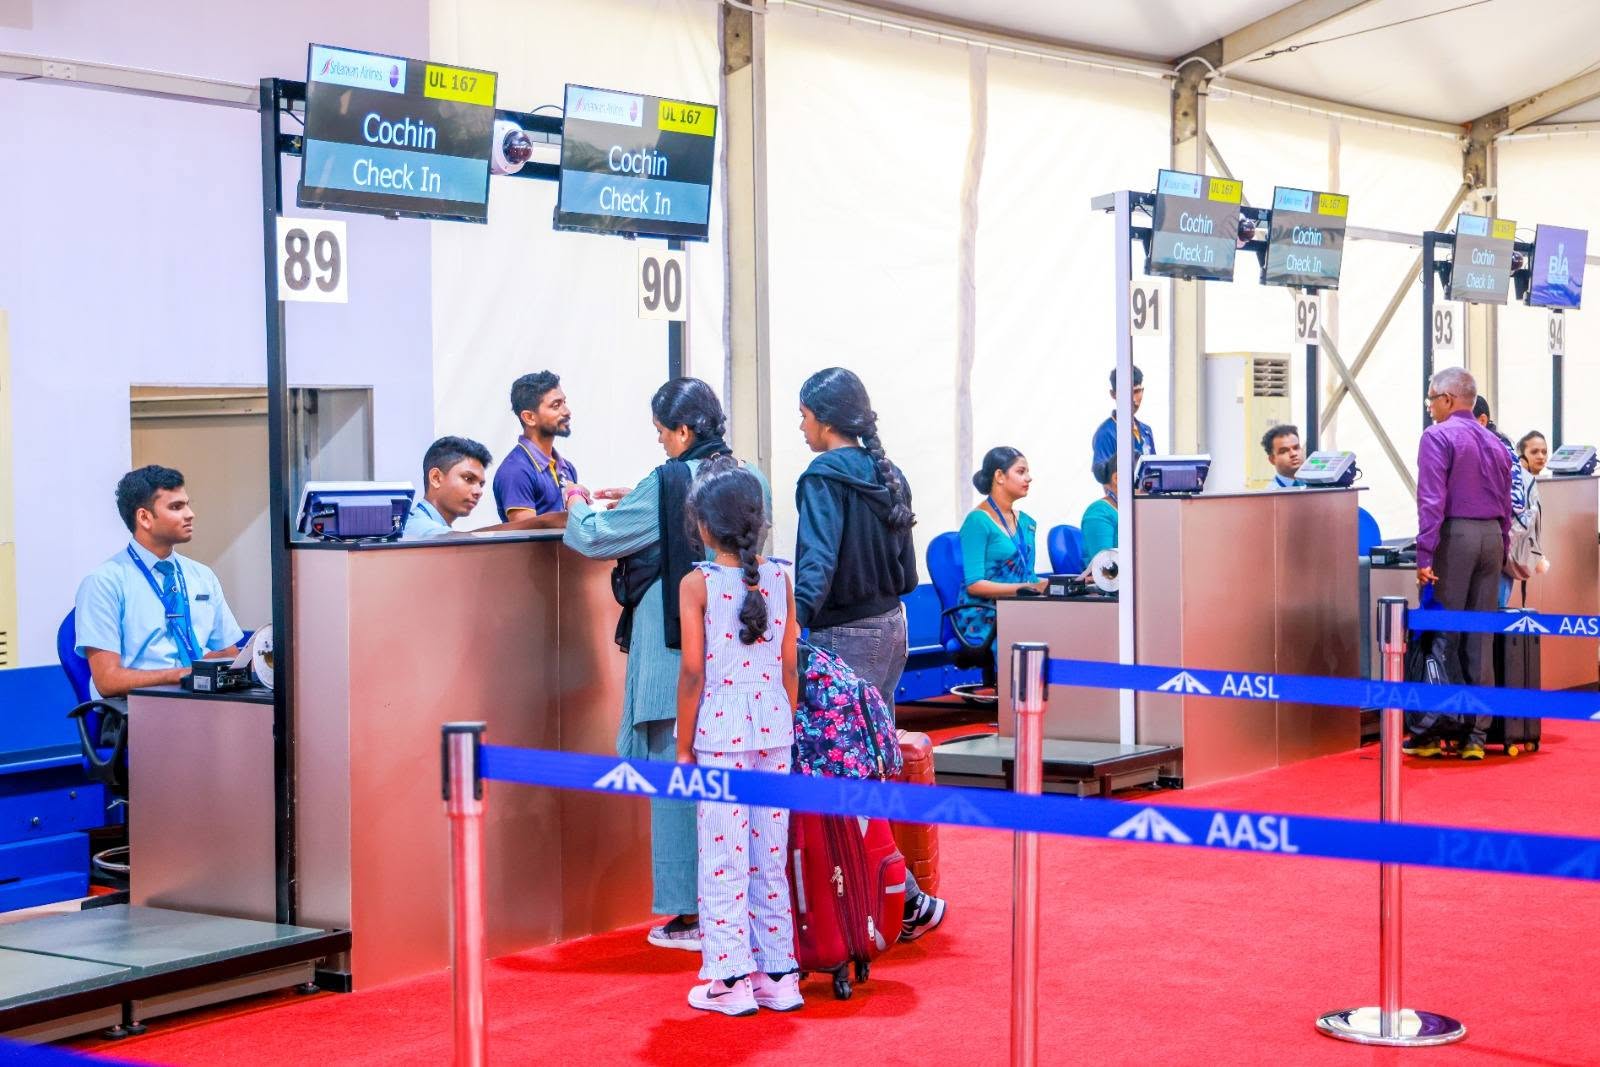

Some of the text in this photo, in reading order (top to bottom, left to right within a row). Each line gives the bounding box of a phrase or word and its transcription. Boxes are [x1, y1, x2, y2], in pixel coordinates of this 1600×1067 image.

[429, 71, 478, 92] UL 167
[662, 105, 702, 125] UL 167
[363, 112, 437, 149] Cochin
[608, 145, 667, 177] Cochin
[353, 158, 441, 192] Check In
[600, 186, 671, 215] Check In
[1211, 182, 1234, 196] UL 167
[1329, 198, 1341, 209] 167
[1180, 212, 1213, 235] Cochin
[1292, 225, 1322, 246] Cochin
[284, 228, 341, 292] 89
[1173, 241, 1213, 262] Check In
[1286, 253, 1322, 272] Check In
[1471, 247, 1496, 266] Cochin
[1549, 249, 1568, 274] BIA
[642, 256, 682, 312] 90
[1466, 272, 1487, 289] Check
[1132, 287, 1160, 330] 91
[1297, 300, 1318, 339] 92
[1435, 310, 1453, 344] 93
[1550, 318, 1563, 350] 94
[1220, 673, 1280, 699] AASL
[667, 766, 737, 801] AASL
[1206, 812, 1299, 853] AASL
